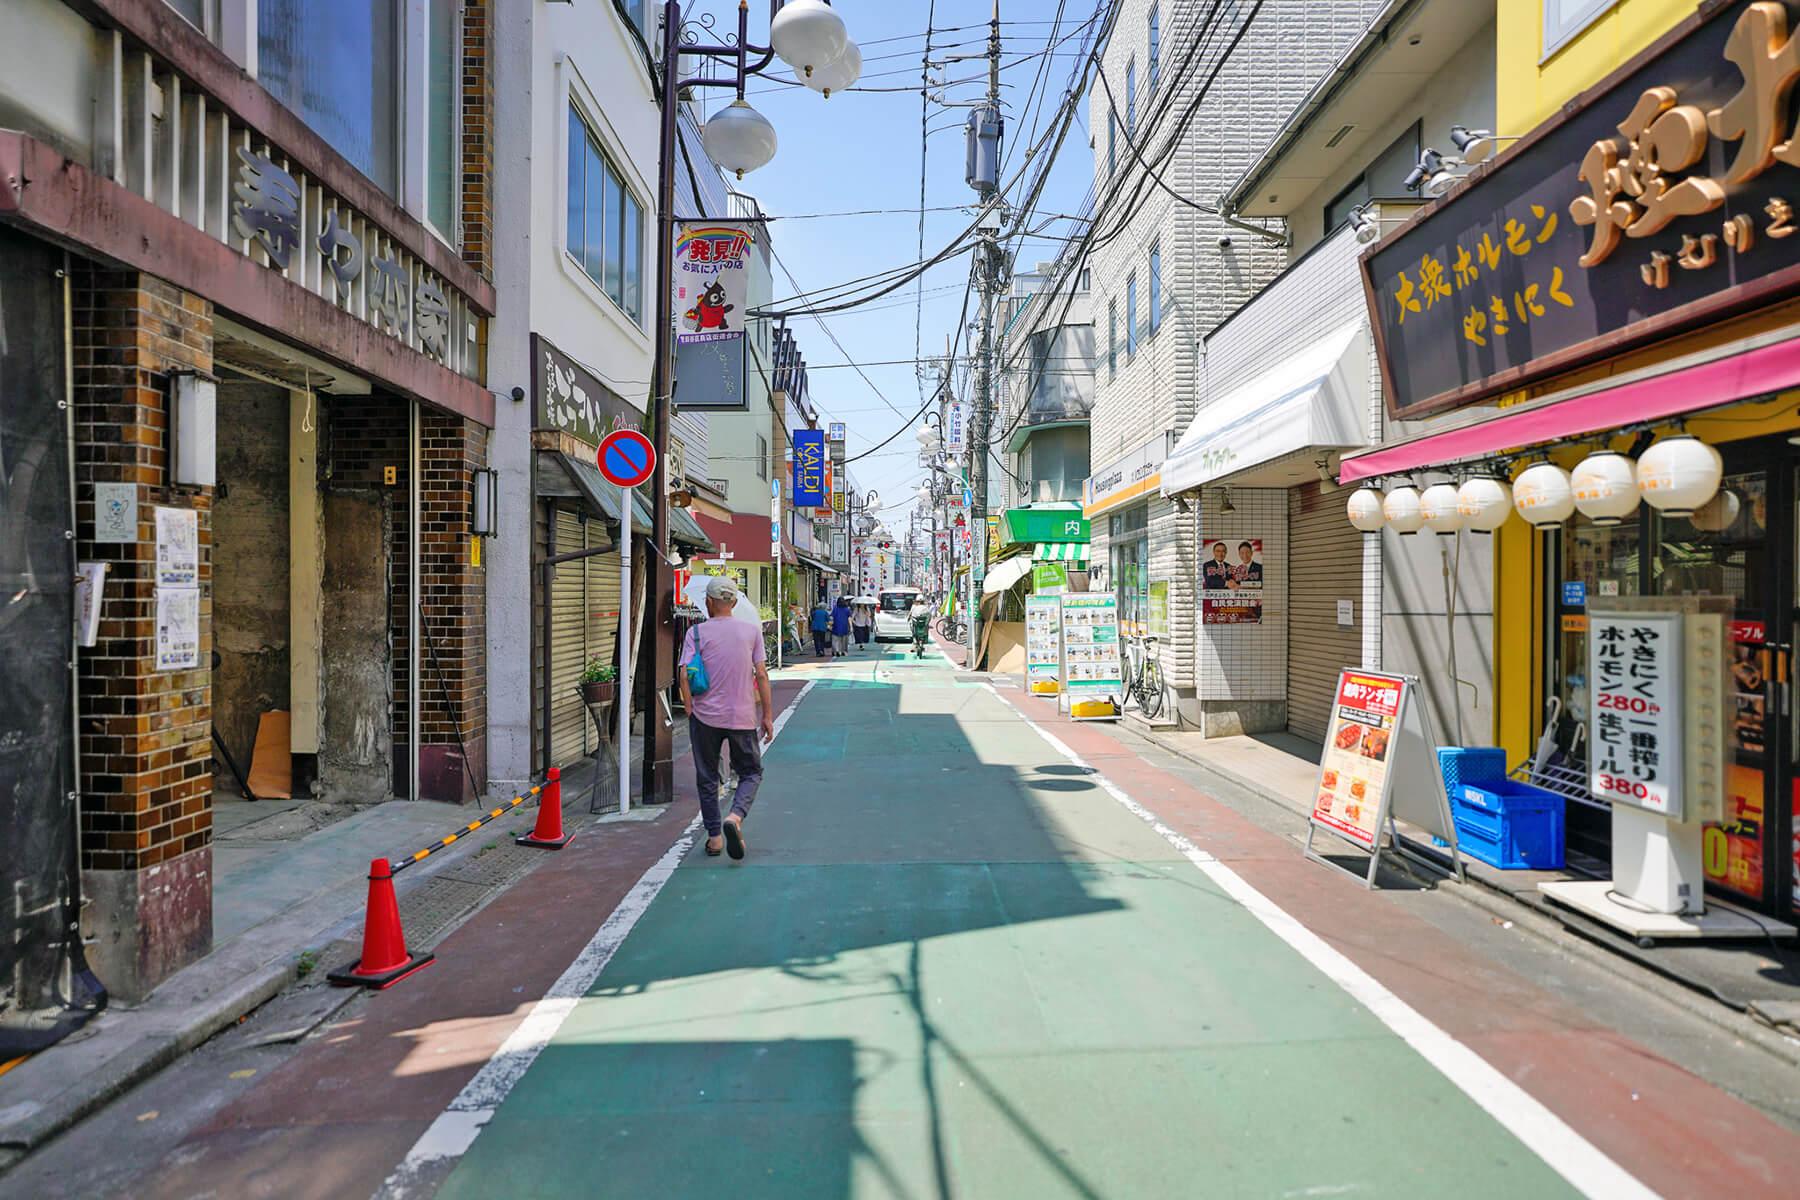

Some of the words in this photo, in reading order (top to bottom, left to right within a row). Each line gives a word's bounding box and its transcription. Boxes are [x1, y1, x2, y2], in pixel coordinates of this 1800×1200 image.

[1395, 204, 1558, 324] 大衆ホルモン
[1640, 196, 1799, 289] けむりき
[1463, 266, 1575, 346] やきにく
[803, 442, 820, 493] KALDI
[1065, 520, 1080, 535] 内
[1597, 626, 1626, 691] ホルモン
[1630, 627, 1660, 698] やきにく
[1598, 712, 1626, 774] 生ビール
[1629, 718, 1660, 781] 一番搾り
